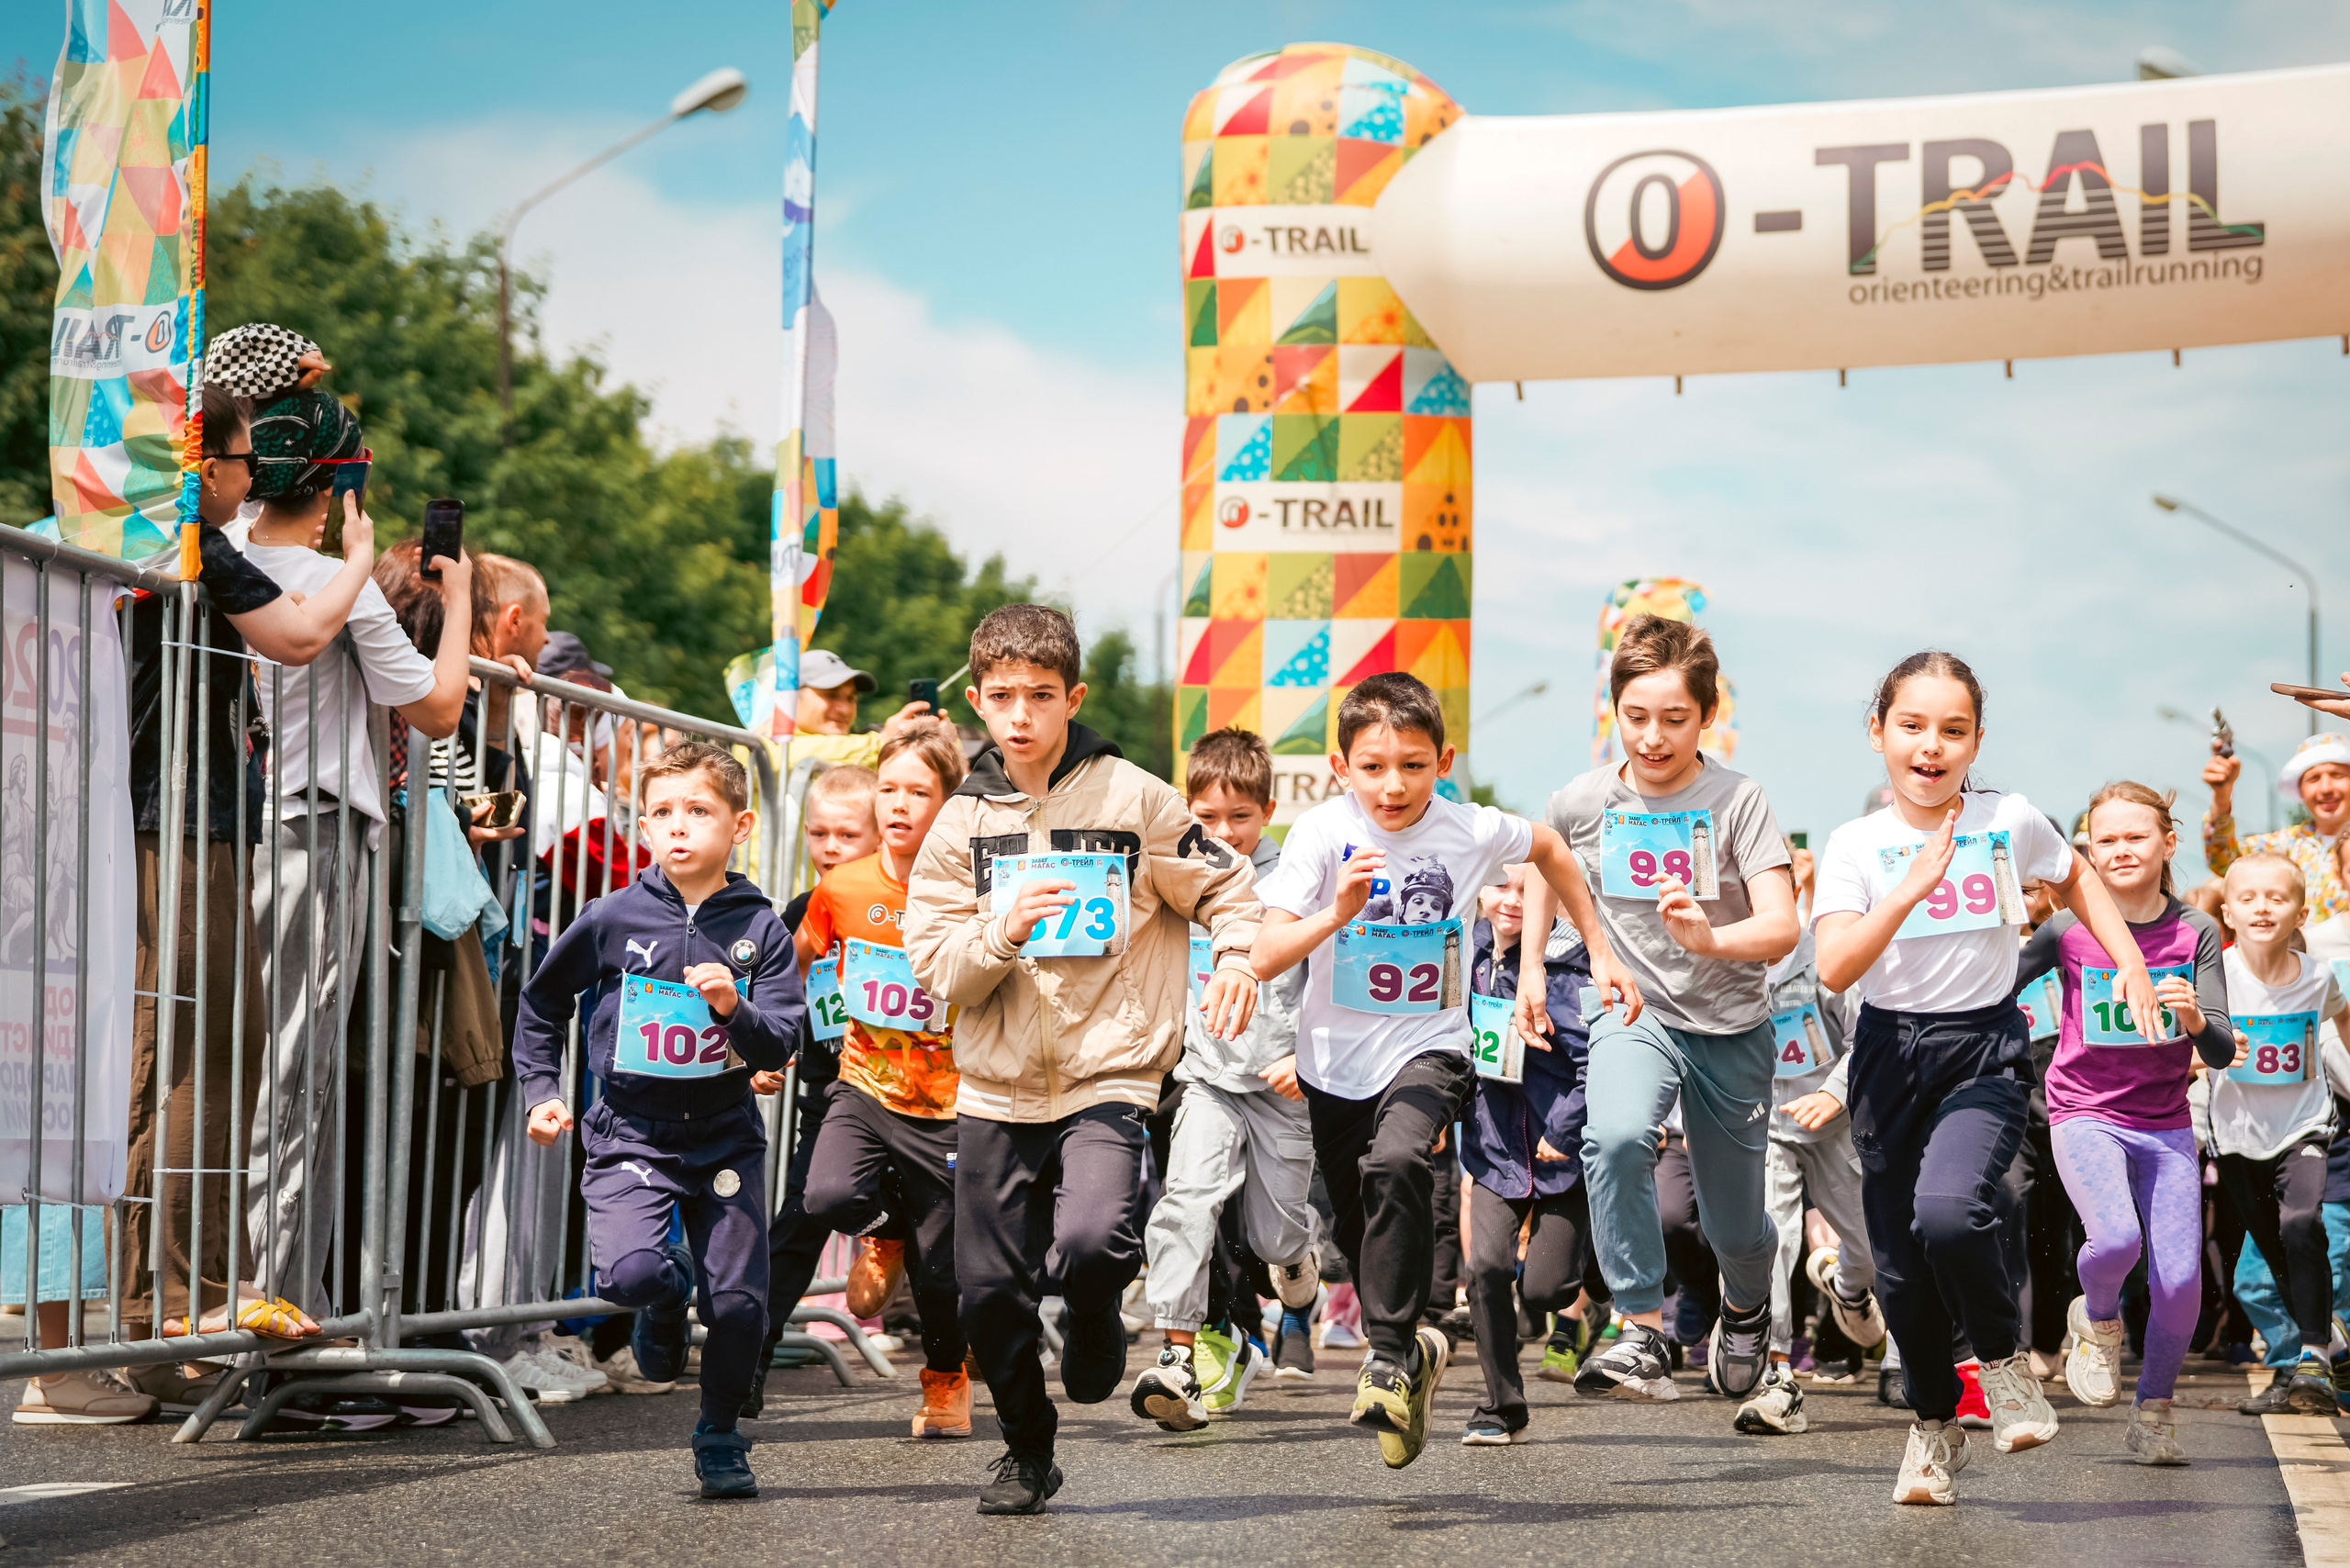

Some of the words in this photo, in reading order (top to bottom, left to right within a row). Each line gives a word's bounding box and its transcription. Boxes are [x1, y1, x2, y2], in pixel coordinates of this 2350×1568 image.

[1849, 252, 2265, 305] orienteering&trailrunning
[1629, 849, 1693, 888] 98
[1925, 873, 1997, 920] 99
[658, 990, 682, 998] МАГАС
[863, 980, 934, 1021] 105
[1369, 963, 1440, 1002] 92
[639, 1022, 729, 1065] 102
[1776, 1039, 1807, 1065] 4
[2255, 1042, 2300, 1074] 83
